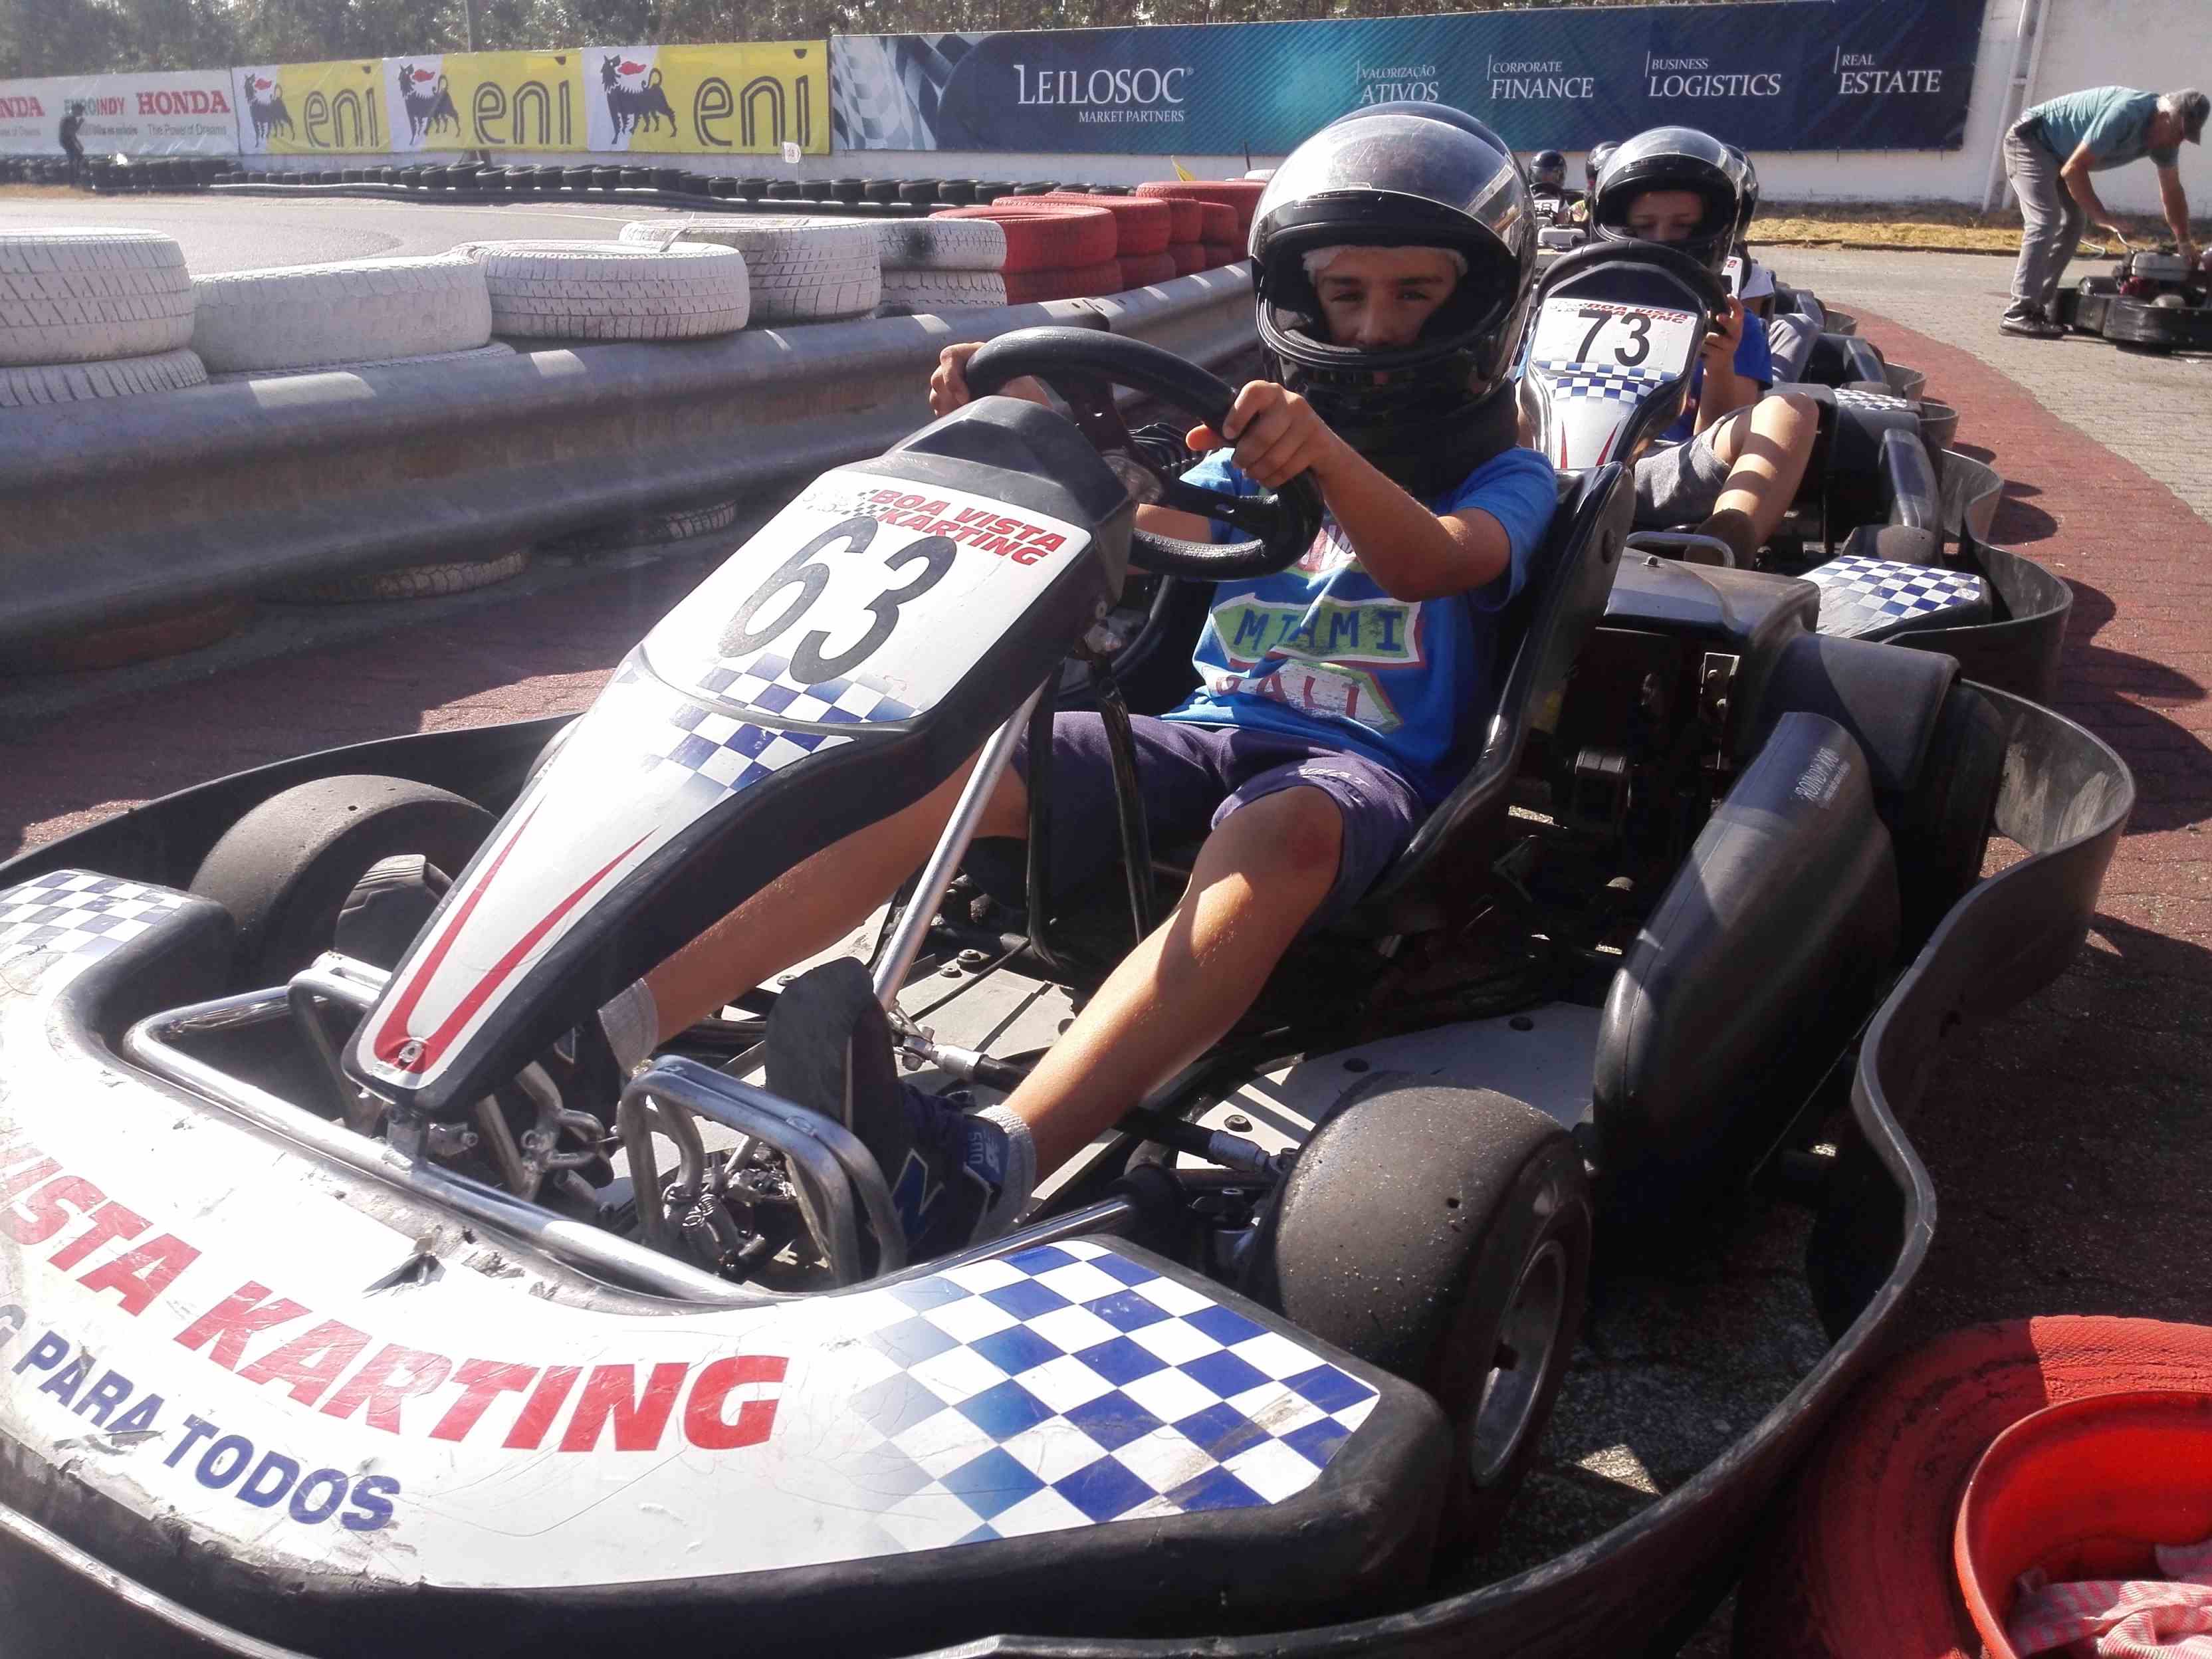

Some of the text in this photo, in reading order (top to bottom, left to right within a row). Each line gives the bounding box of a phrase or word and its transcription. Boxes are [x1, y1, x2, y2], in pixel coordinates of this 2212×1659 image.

[1362, 64, 1436, 79] VALORIZAÇÃO
[1493, 61, 1562, 73] CORPORATE
[1652, 58, 1709, 70] BUSINESS
[1842, 54, 1876, 66] REAL
[1359, 81, 1439, 104] ATIVOS
[1490, 77, 1595, 99] FINANCE
[1648, 74, 1781, 97] LOGISTICS
[1838, 69, 1943, 94] ESTATE
[136, 90, 231, 115] HONDA
[304, 65, 379, 148] eni
[473, 56, 572, 145] eni
[693, 49, 810, 146] eni
[1079, 110, 1184, 122] MARKET PARTNERS
[1576, 309, 1652, 366] 73
[871, 489, 1067, 552] BOA VISTA
[878, 508, 1049, 566] KARTING
[718, 516, 956, 685] 63
[173, 1280, 790, 1452] KARTING
[11, 1330, 400, 1531] PARA TODOS
